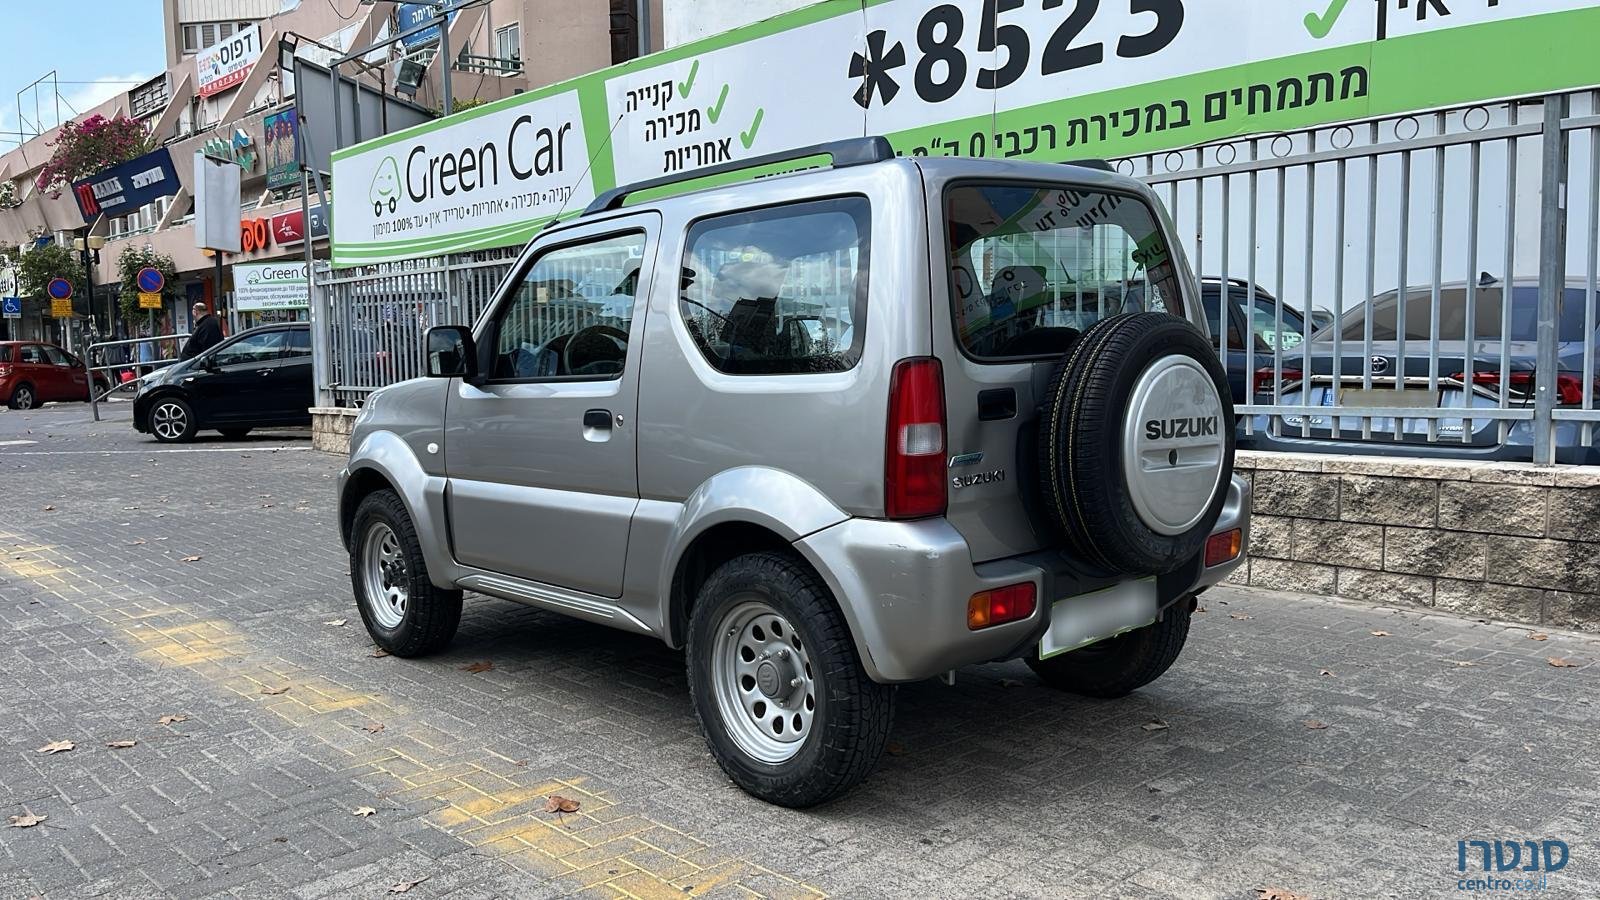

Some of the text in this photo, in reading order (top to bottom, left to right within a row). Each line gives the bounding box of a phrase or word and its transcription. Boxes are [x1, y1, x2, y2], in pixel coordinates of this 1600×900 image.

[220, 33, 252, 65] דפוס
[626, 80, 674, 113] קנייה
[1204, 63, 1370, 123] מתמחים
[645, 108, 701, 142] מכירה
[1067, 98, 1191, 149] במכירת
[663, 137, 732, 173] אחריות
[994, 124, 1056, 158] רכבי
[406, 115, 572, 203] Green Car
[372, 185, 572, 240] קניה מכירה אחריות טרייד אין עד 100% מימון
[262, 267, 299, 280] Green
[1145, 416, 1218, 441] SUZUKI
[953, 470, 1005, 489] SUZUKI
